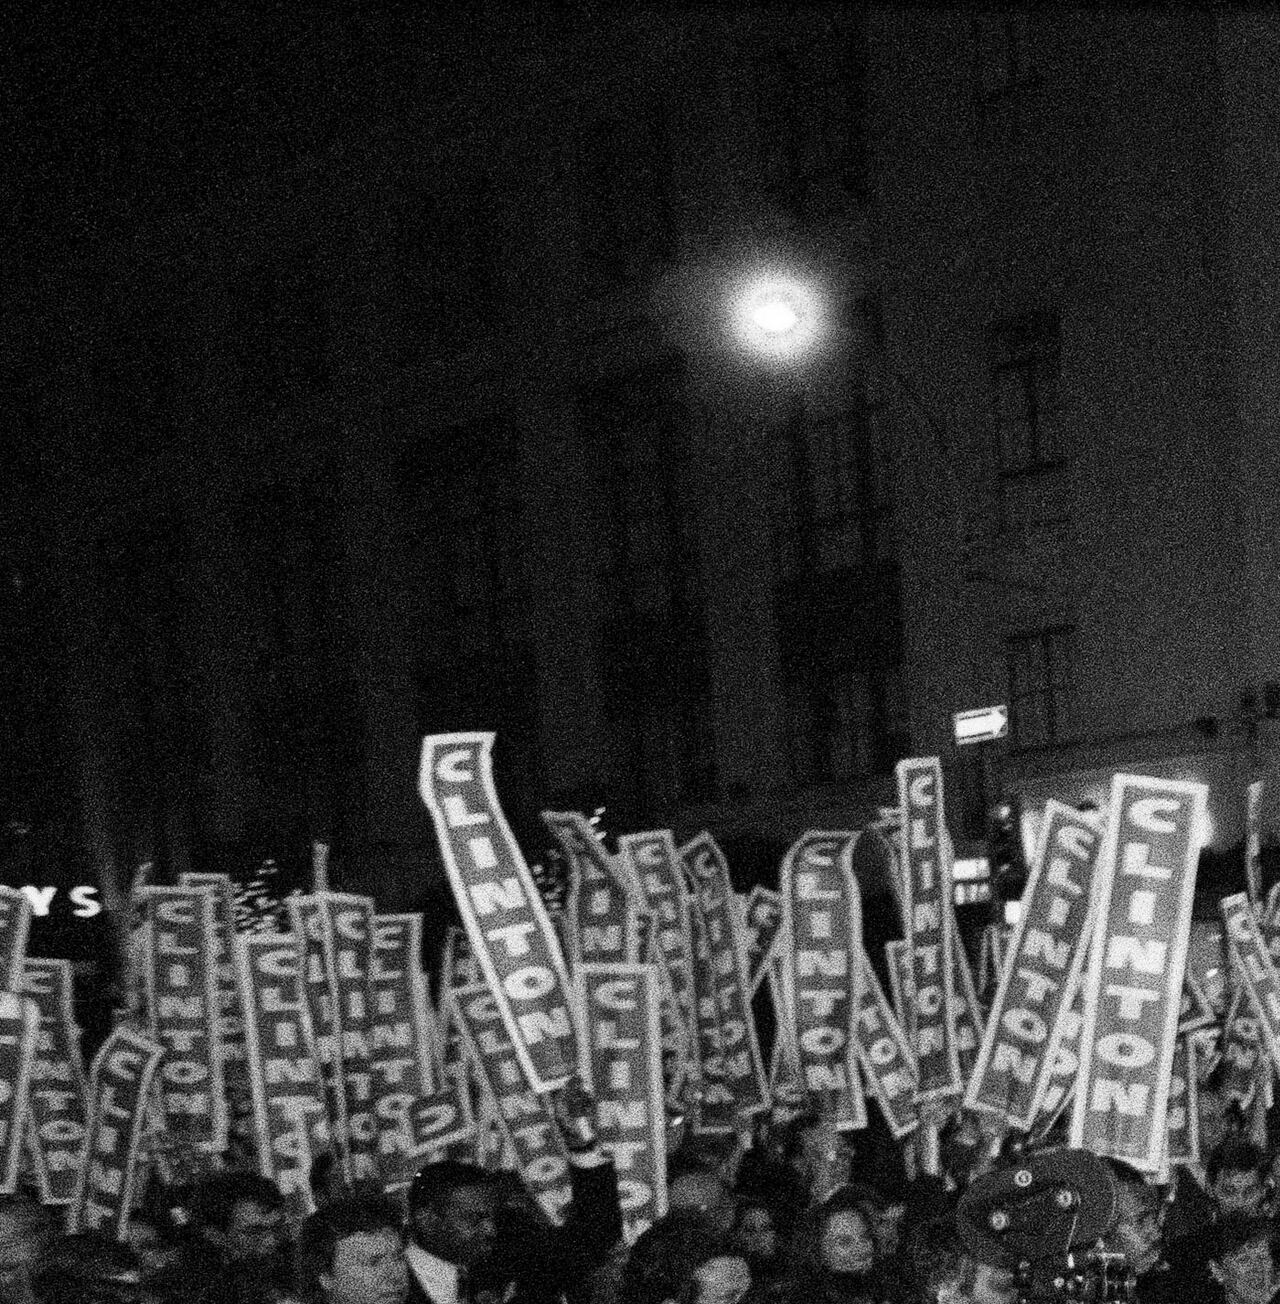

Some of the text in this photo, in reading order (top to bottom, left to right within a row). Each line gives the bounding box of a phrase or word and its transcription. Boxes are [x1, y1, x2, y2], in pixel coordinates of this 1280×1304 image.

[157, 901, 208, 1115] CLINTON
[436, 749, 572, 1046] CLINTON
[796, 842, 850, 1091] CLINTON
[909, 775, 944, 1056] CLINTON
[993, 825, 1095, 1085] CLINTON
[1092, 799, 1182, 1117] CLINTON
